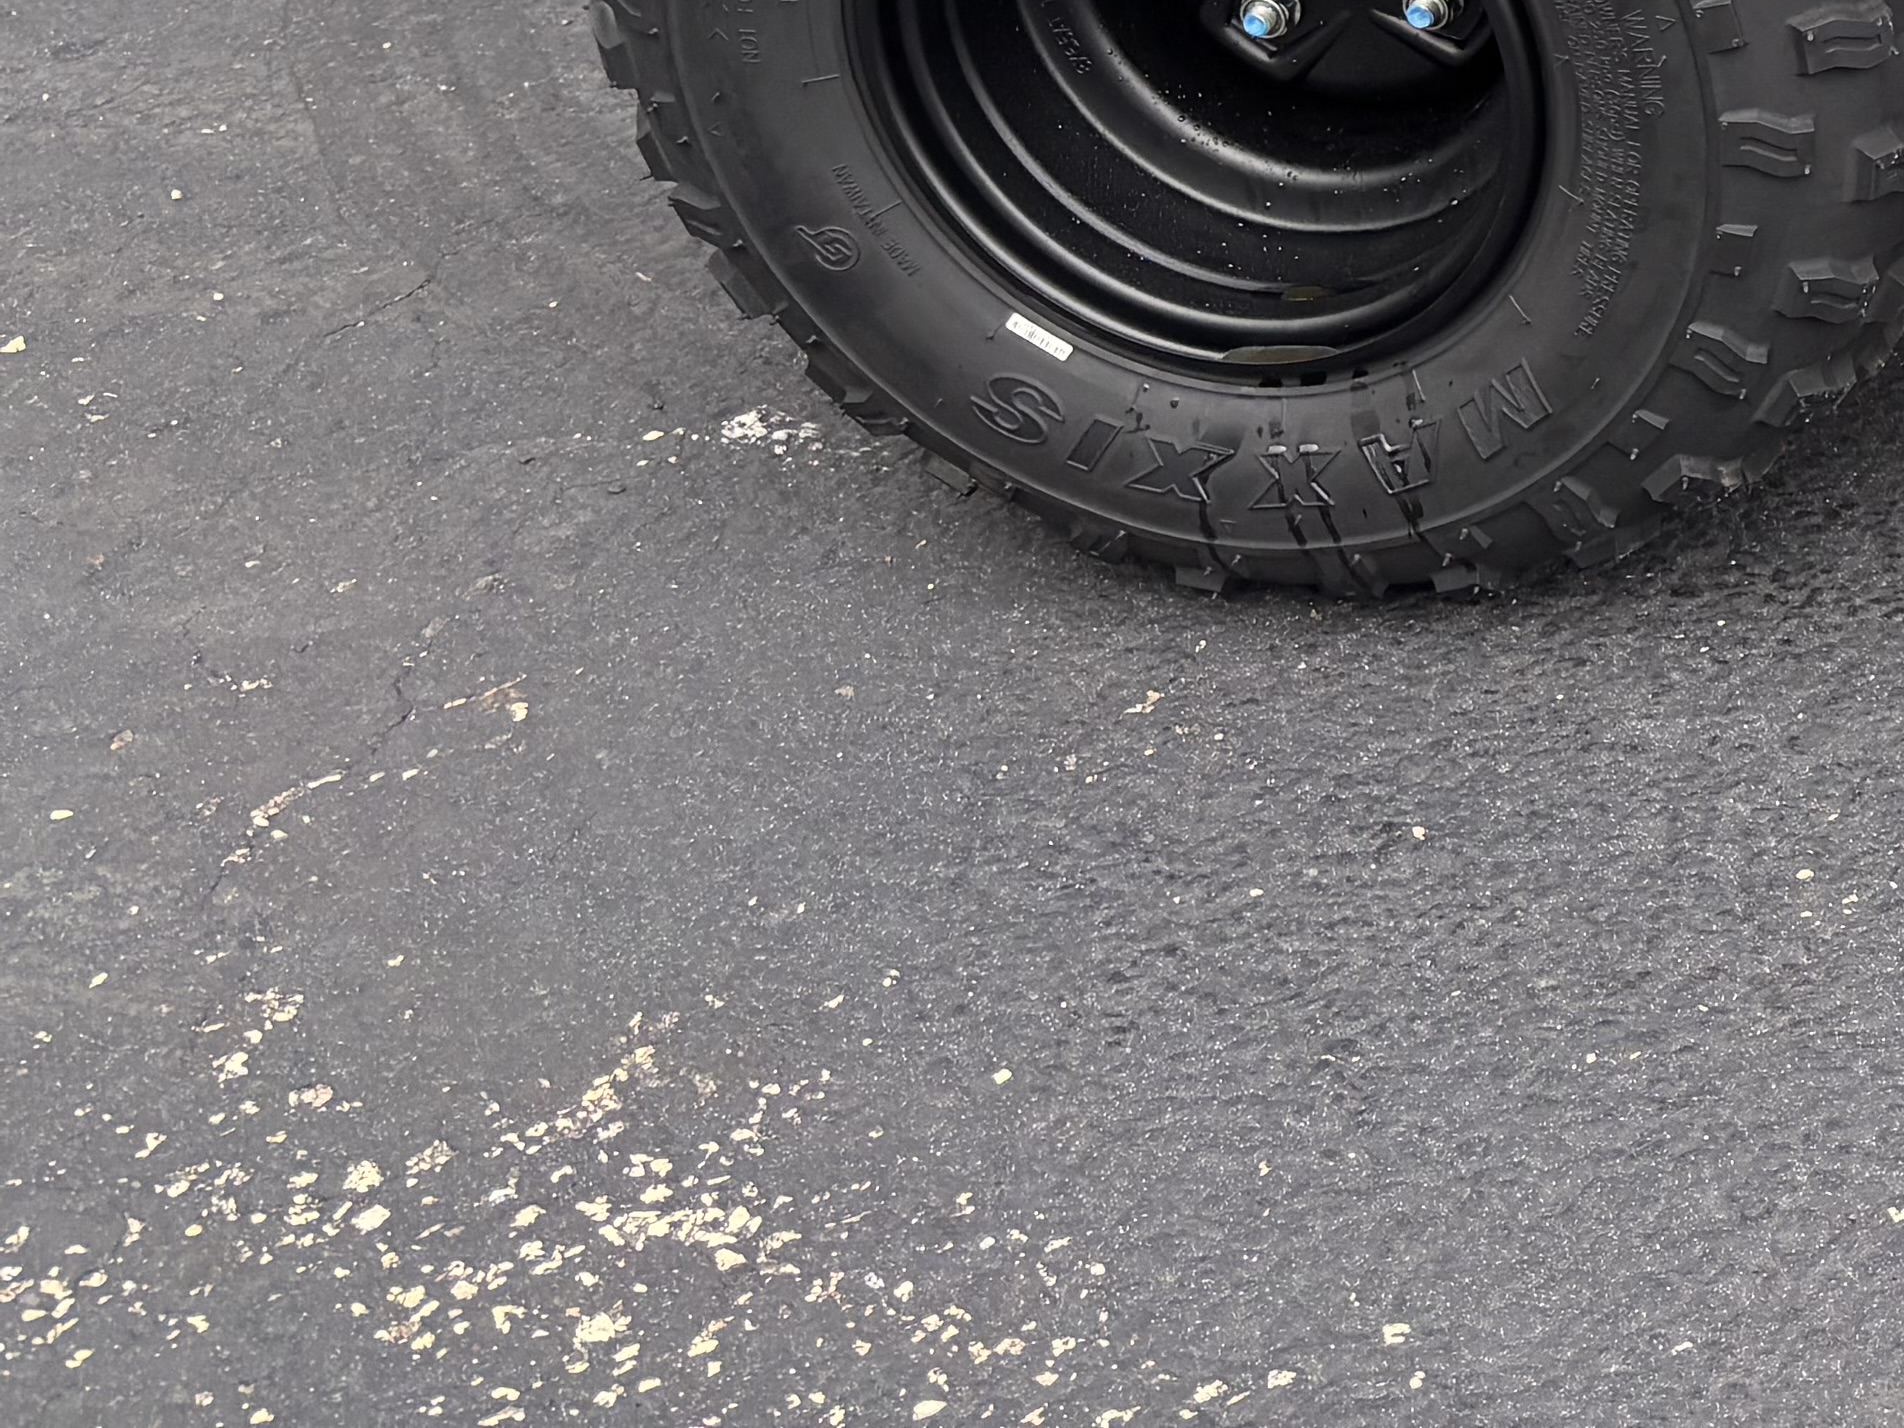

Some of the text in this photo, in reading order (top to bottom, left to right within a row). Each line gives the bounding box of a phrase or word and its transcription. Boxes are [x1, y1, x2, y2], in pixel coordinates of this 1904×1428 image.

[736, 27, 761, 63] NOT
[1619, 8, 1663, 119] WARNING
[829, 160, 922, 279] MADE IN TAIWAN
[971, 351, 1549, 510] MAXXIS
